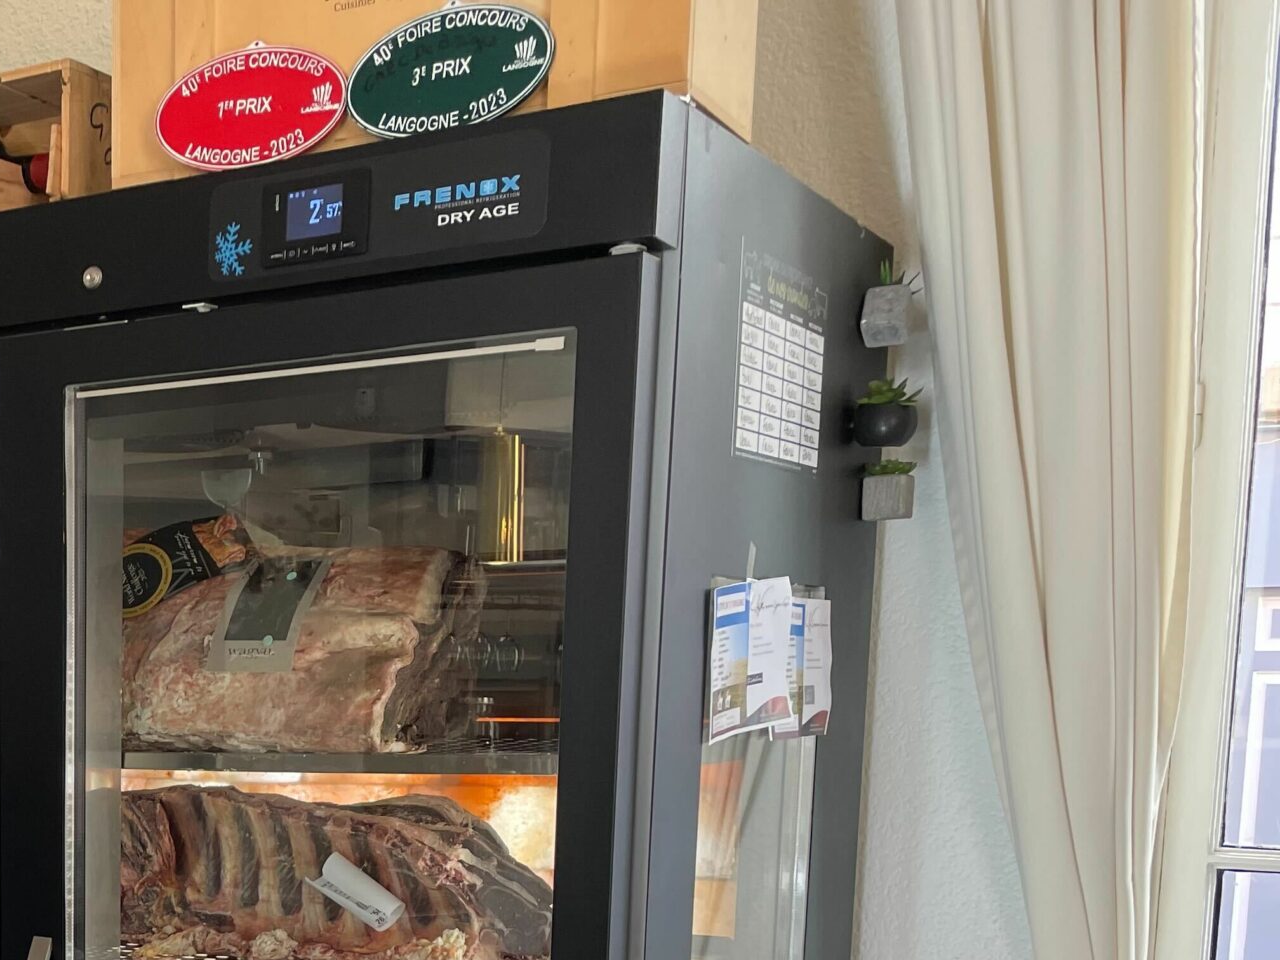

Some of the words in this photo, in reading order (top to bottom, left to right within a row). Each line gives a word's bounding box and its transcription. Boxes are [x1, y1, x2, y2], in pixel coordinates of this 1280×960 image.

[396, 17, 441, 48] FOIRE
[445, 9, 529, 32] CONCOURS
[204, 55, 246, 82] FOIRE
[248, 52, 326, 77] CONCOURS
[431, 55, 472, 81] PRIX
[235, 96, 272, 116] PRIX
[378, 110, 460, 133] LANGOGNE
[184, 143, 261, 164] LANGOGNE
[394, 174, 520, 211] FRENOX
[437, 209, 475, 227] DRY
[478, 202, 519, 220] AGE
